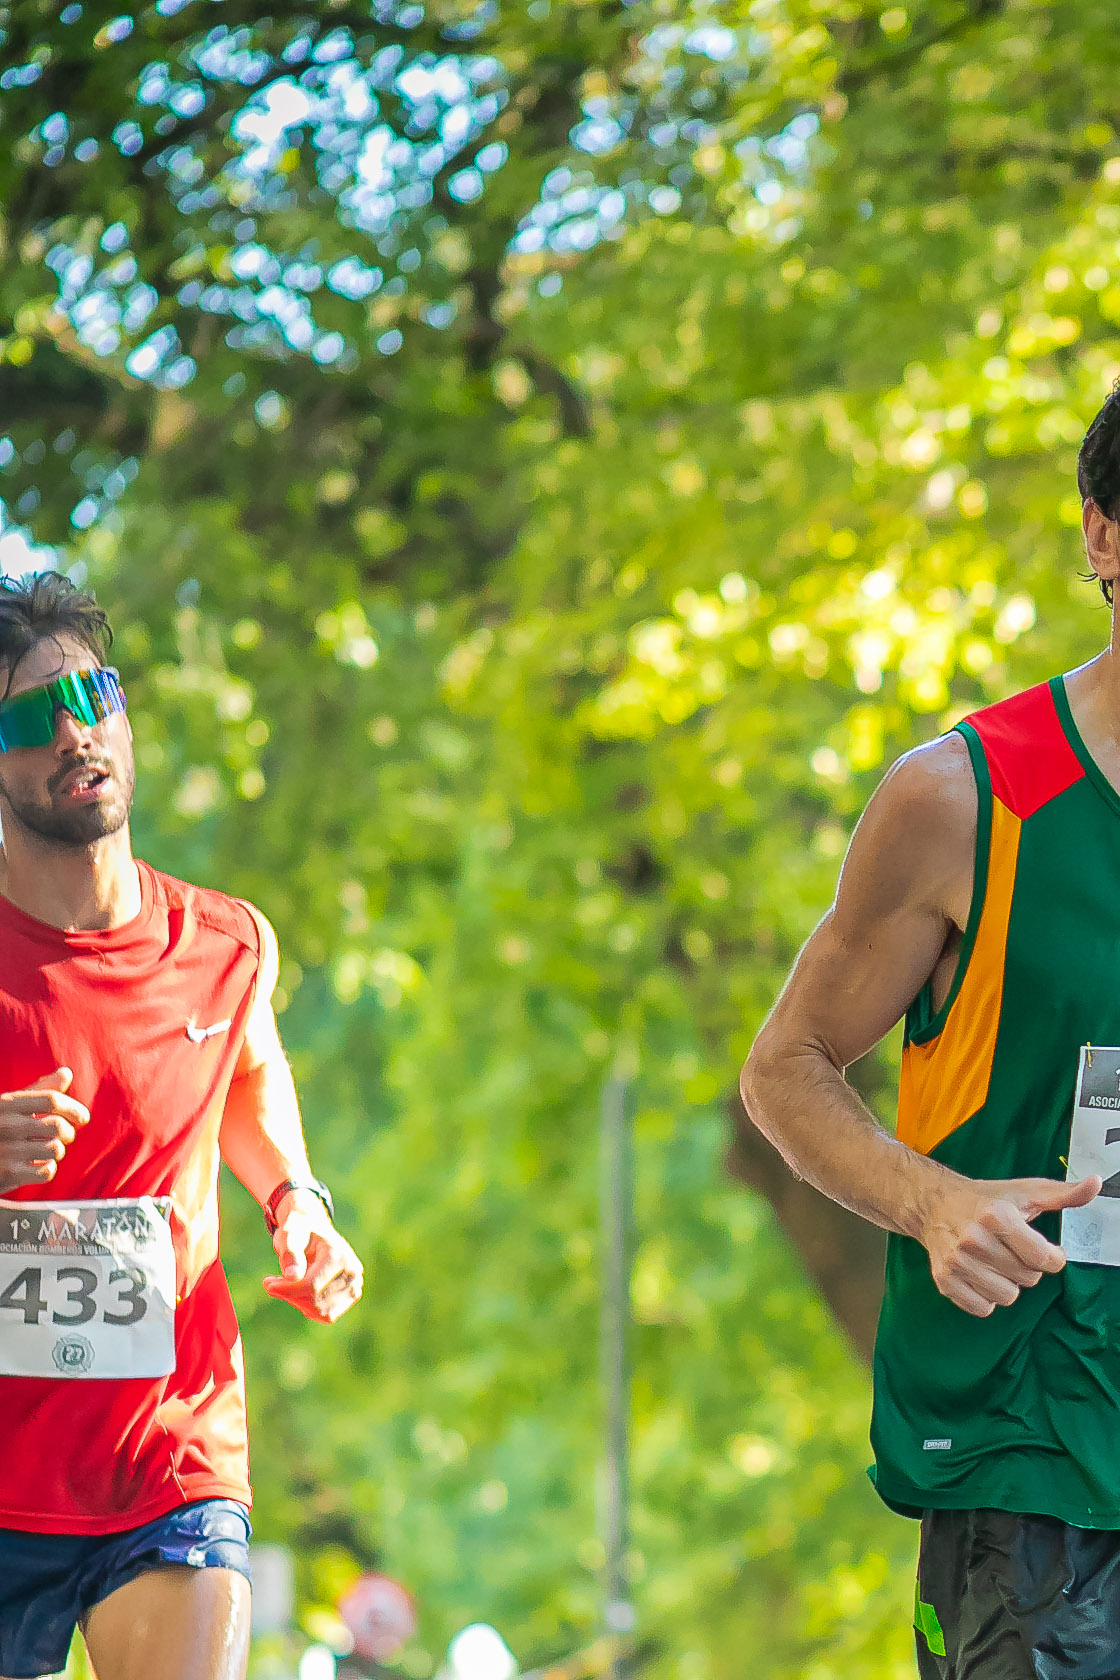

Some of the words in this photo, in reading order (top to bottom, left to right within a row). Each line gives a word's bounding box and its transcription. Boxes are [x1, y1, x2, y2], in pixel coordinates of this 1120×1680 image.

[37, 1210, 149, 1242] MARATÓN
[0, 1240, 38, 1254] OCIACIÓN
[0, 1267, 147, 1326] 433
[65, 1345, 83, 1361] 27
